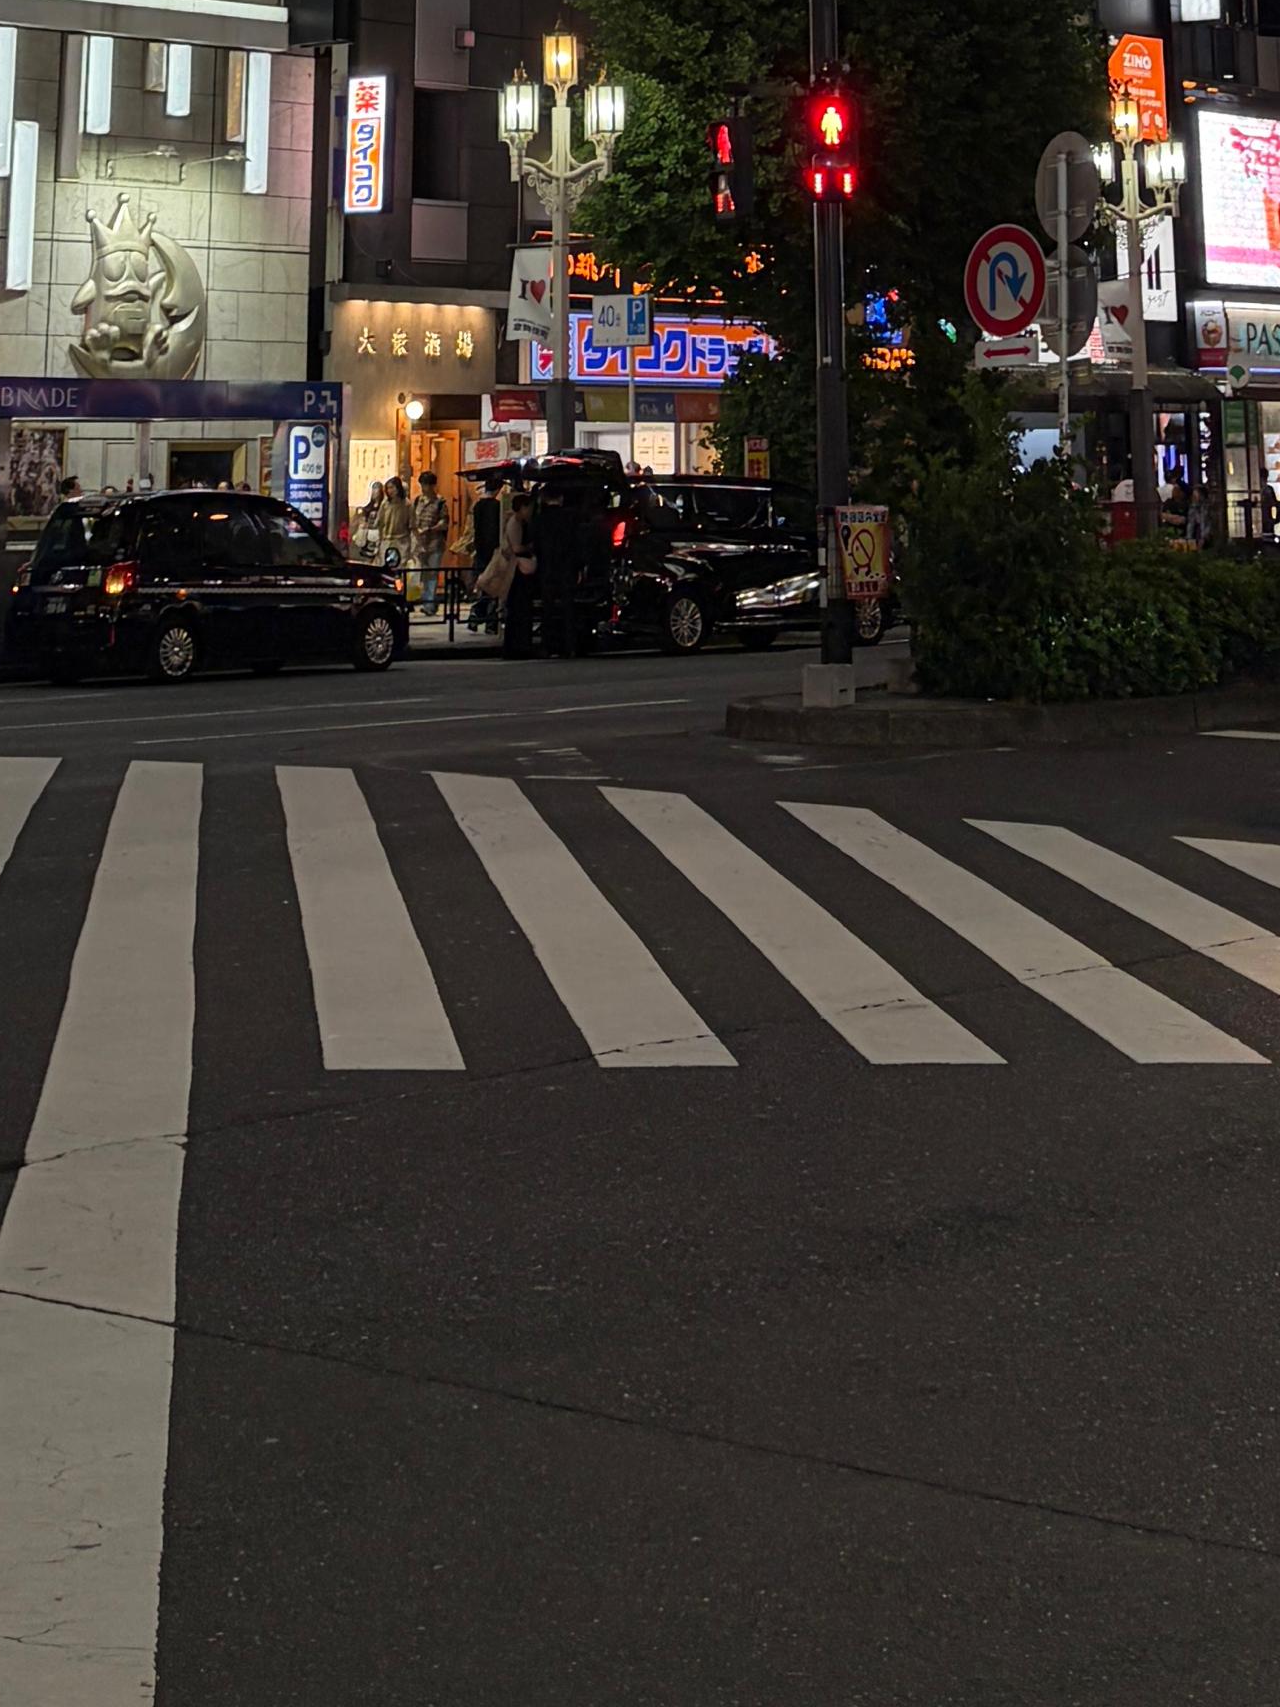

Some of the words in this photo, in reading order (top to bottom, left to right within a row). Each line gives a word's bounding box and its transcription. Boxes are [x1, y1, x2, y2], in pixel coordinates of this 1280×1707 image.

[1122, 52, 1152, 71] ZINO
[357, 328, 475, 361] 大衆酒場
[304, 390, 317, 414] P
[293, 434, 313, 475] P
